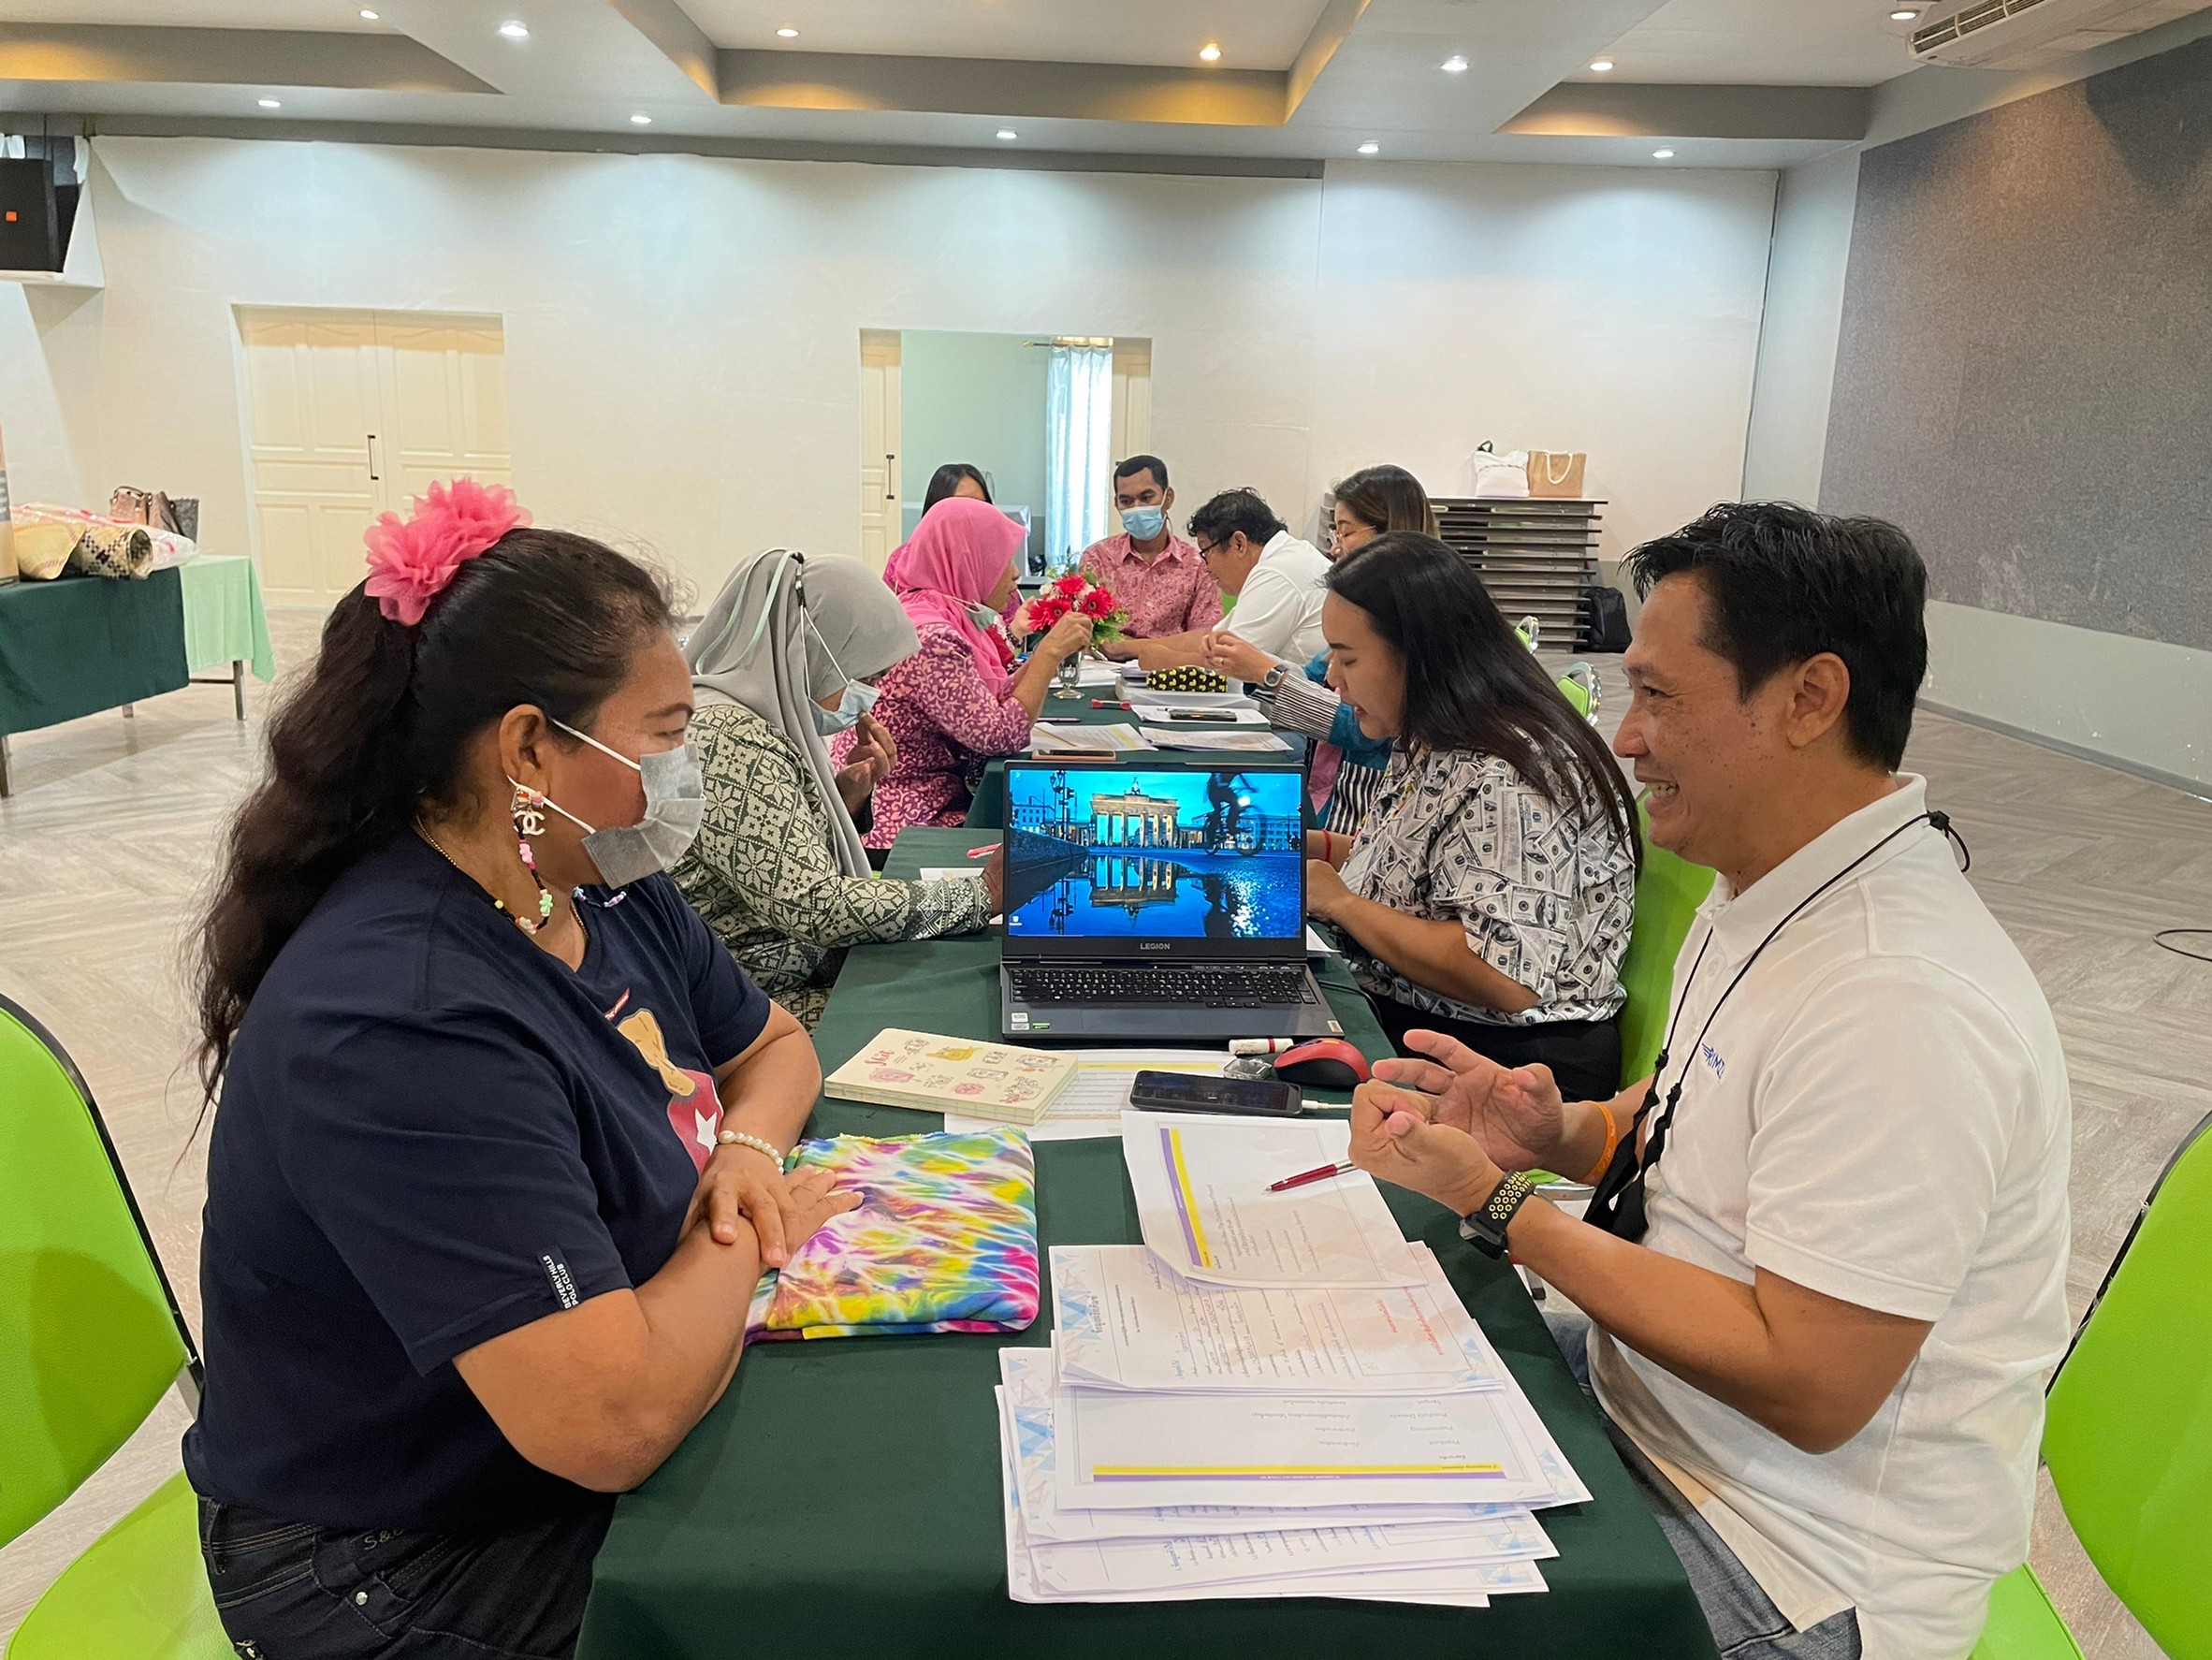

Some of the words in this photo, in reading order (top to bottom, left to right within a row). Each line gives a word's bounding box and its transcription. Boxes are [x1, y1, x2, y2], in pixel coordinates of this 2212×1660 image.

[543, 1255, 558, 1275] HILLS
[556, 1263, 570, 1284] CLUB
[551, 1274, 572, 1309] BEVERLY
[565, 1283, 579, 1306] POLO
